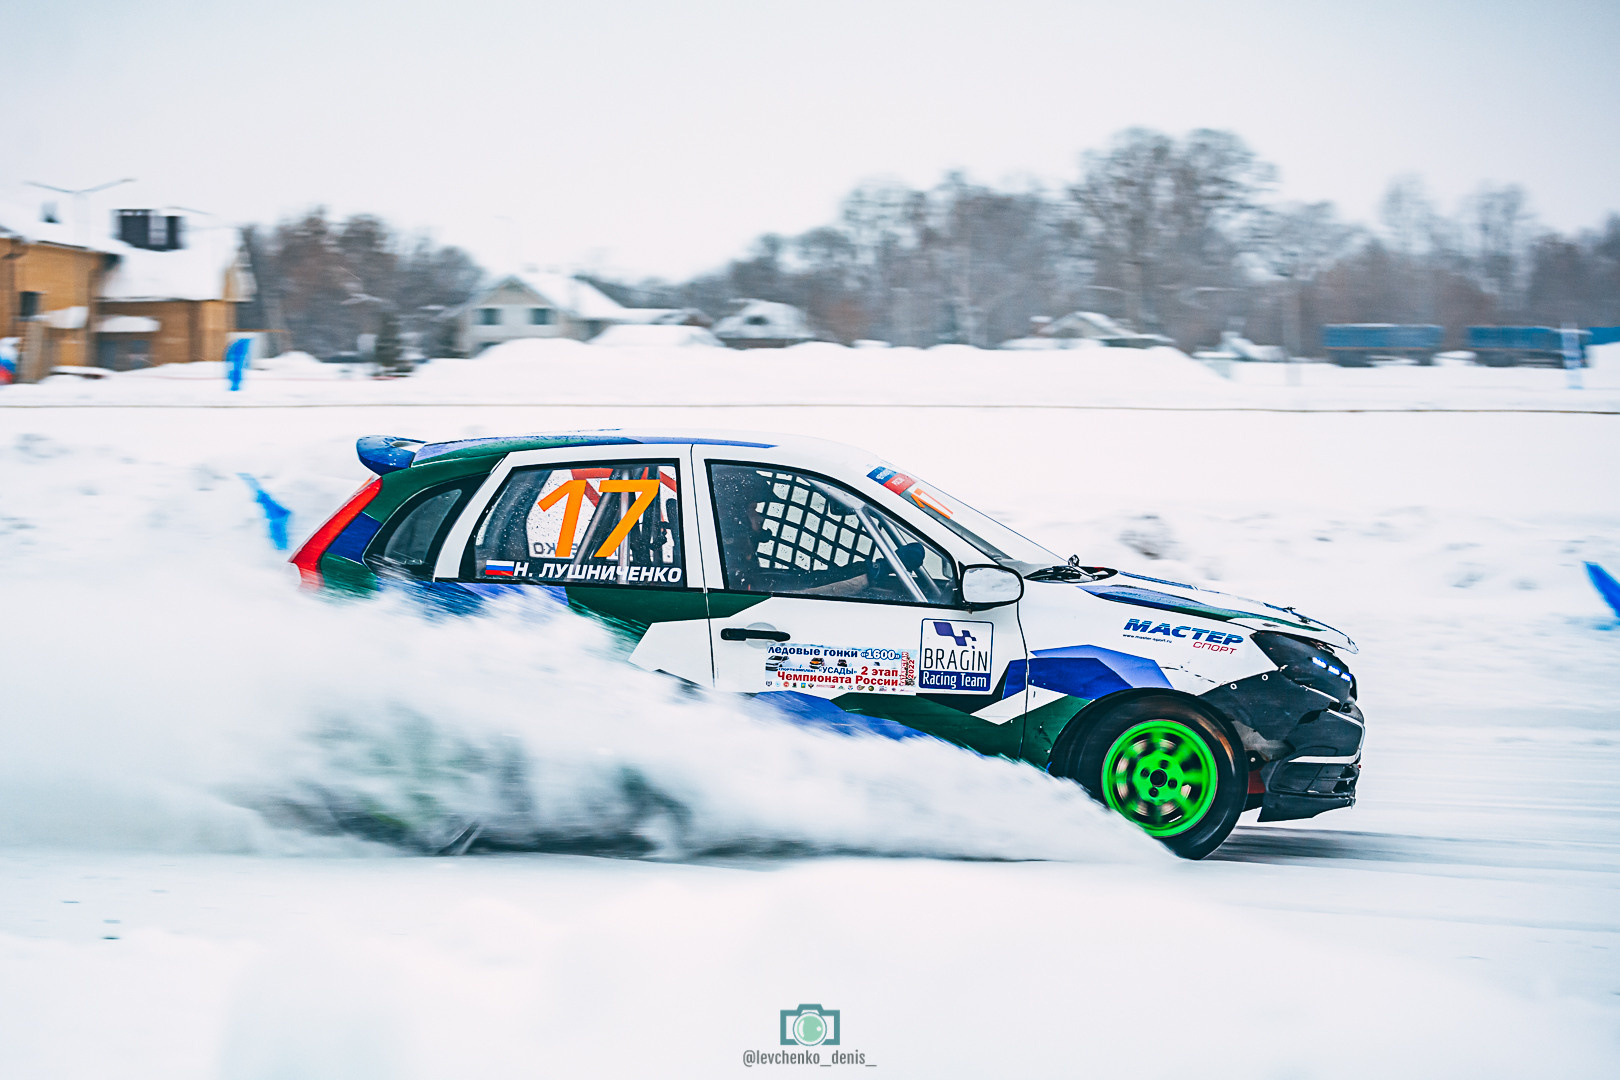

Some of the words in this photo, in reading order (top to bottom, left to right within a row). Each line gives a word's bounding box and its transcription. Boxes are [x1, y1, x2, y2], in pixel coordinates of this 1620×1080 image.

[537, 479, 660, 557] 17
[513, 562, 533, 578] Н.
[539, 562, 682, 583] ЛУШНИЧЕНКО
[1123, 618, 1244, 646] МАСТЕР
[823, 648, 858, 659] гонки
[1192, 641, 1238, 655] СПОРТ
[860, 666, 869, 676] 2
[871, 668, 899, 678] этап
[907, 659, 915, 679] 2022
[777, 671, 852, 685] Чемпионата
[855, 675, 899, 687] России
[922, 671, 957, 690] Racing
[960, 672, 987, 688] Team
